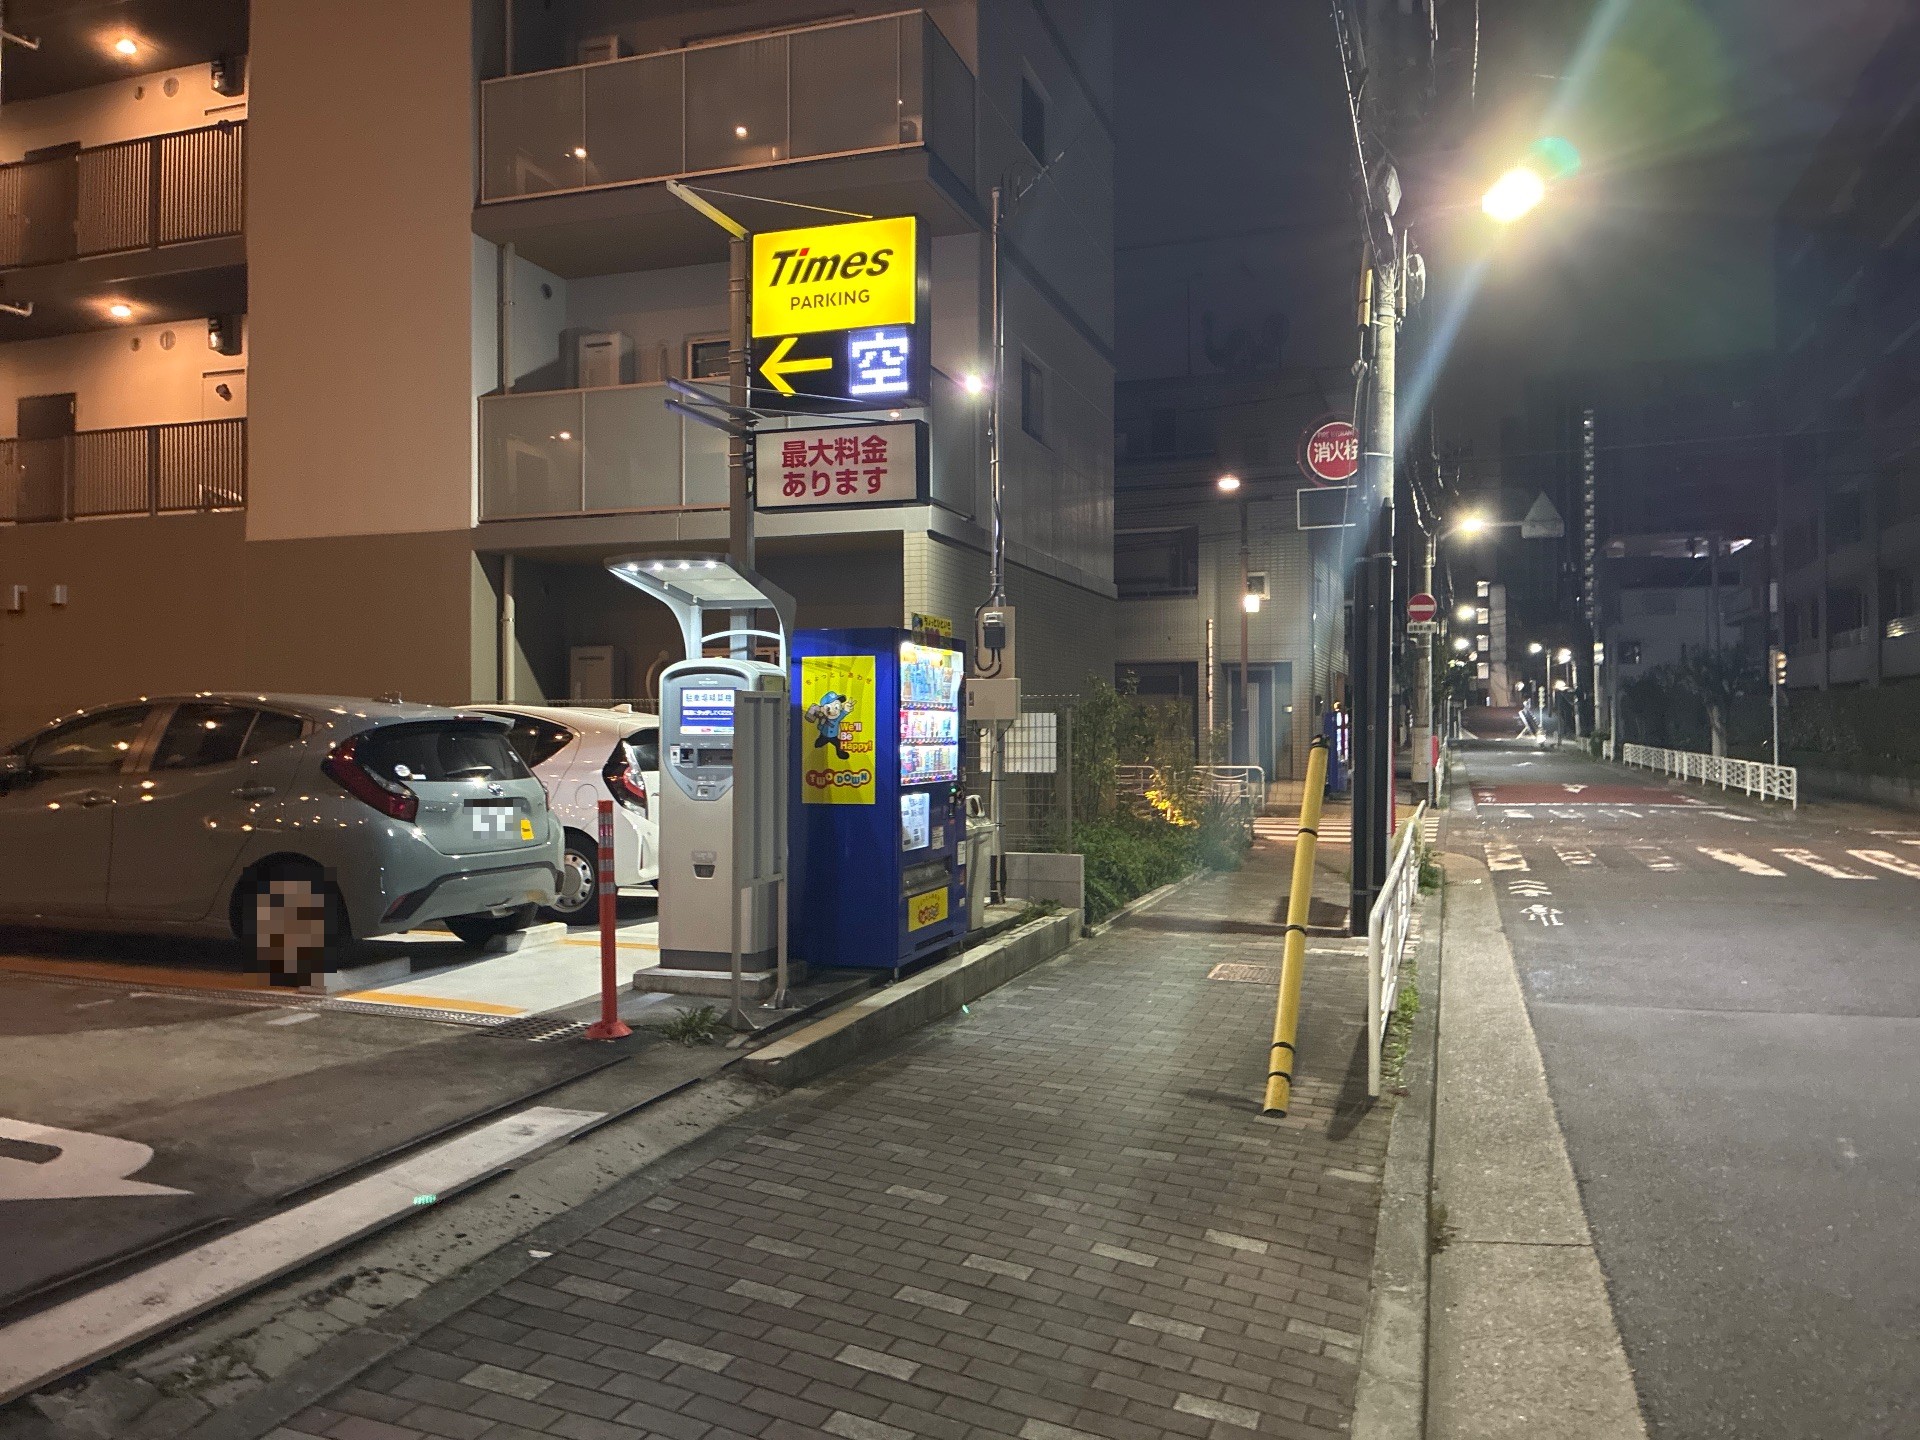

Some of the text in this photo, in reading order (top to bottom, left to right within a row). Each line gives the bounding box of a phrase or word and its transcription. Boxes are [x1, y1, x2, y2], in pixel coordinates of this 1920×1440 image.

[769, 247, 893, 287] Times
[790, 289, 870, 310] PARKING
[852, 331, 908, 394] 空
[781, 434, 888, 468] 最大料金
[782, 466, 888, 497] あります
[840, 732, 853, 740] Be
